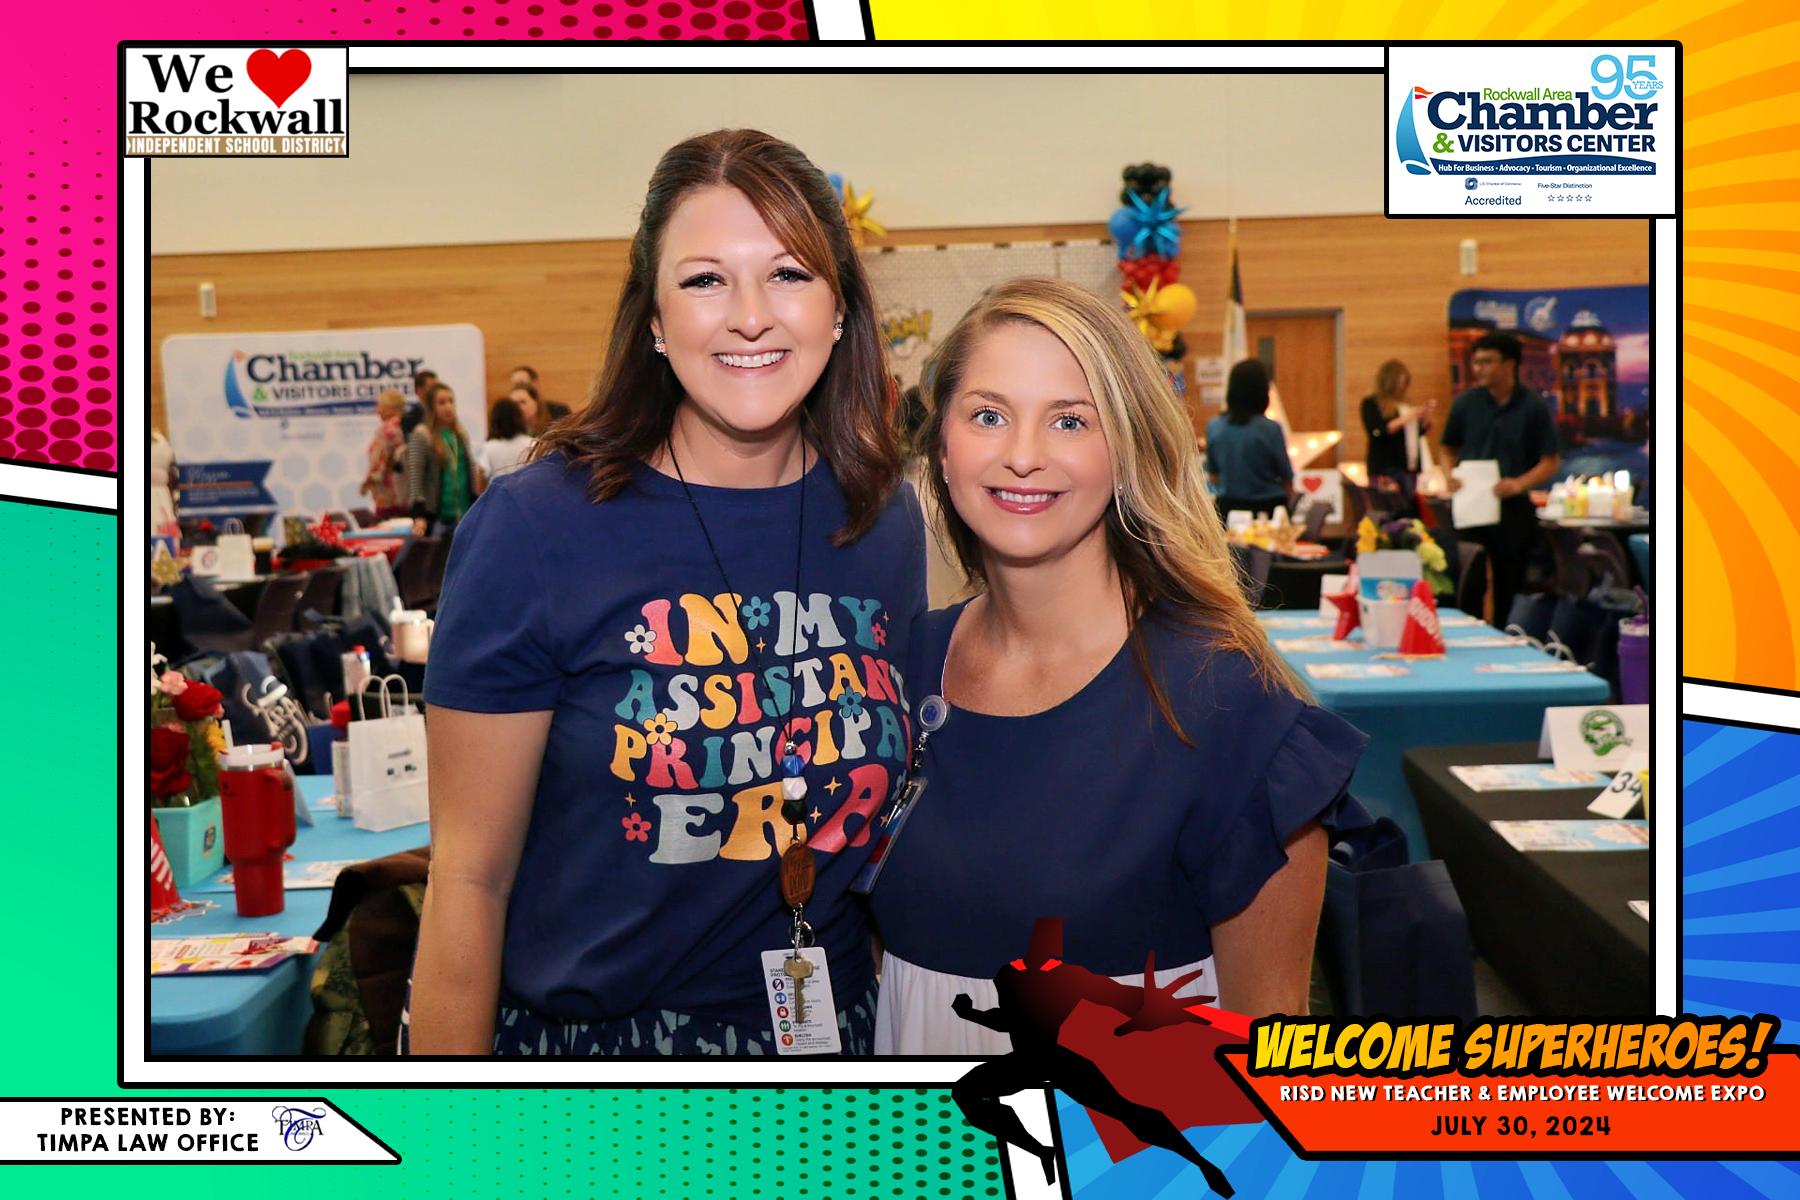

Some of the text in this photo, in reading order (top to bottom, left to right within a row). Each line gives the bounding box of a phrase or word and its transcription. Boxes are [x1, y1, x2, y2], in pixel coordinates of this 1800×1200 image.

[247, 351, 424, 384] Chamber
[272, 384, 351, 400] VISITORS
[641, 590, 882, 667] IN MY
[1611, 771, 1642, 797] 34
[648, 763, 890, 865] ERA
